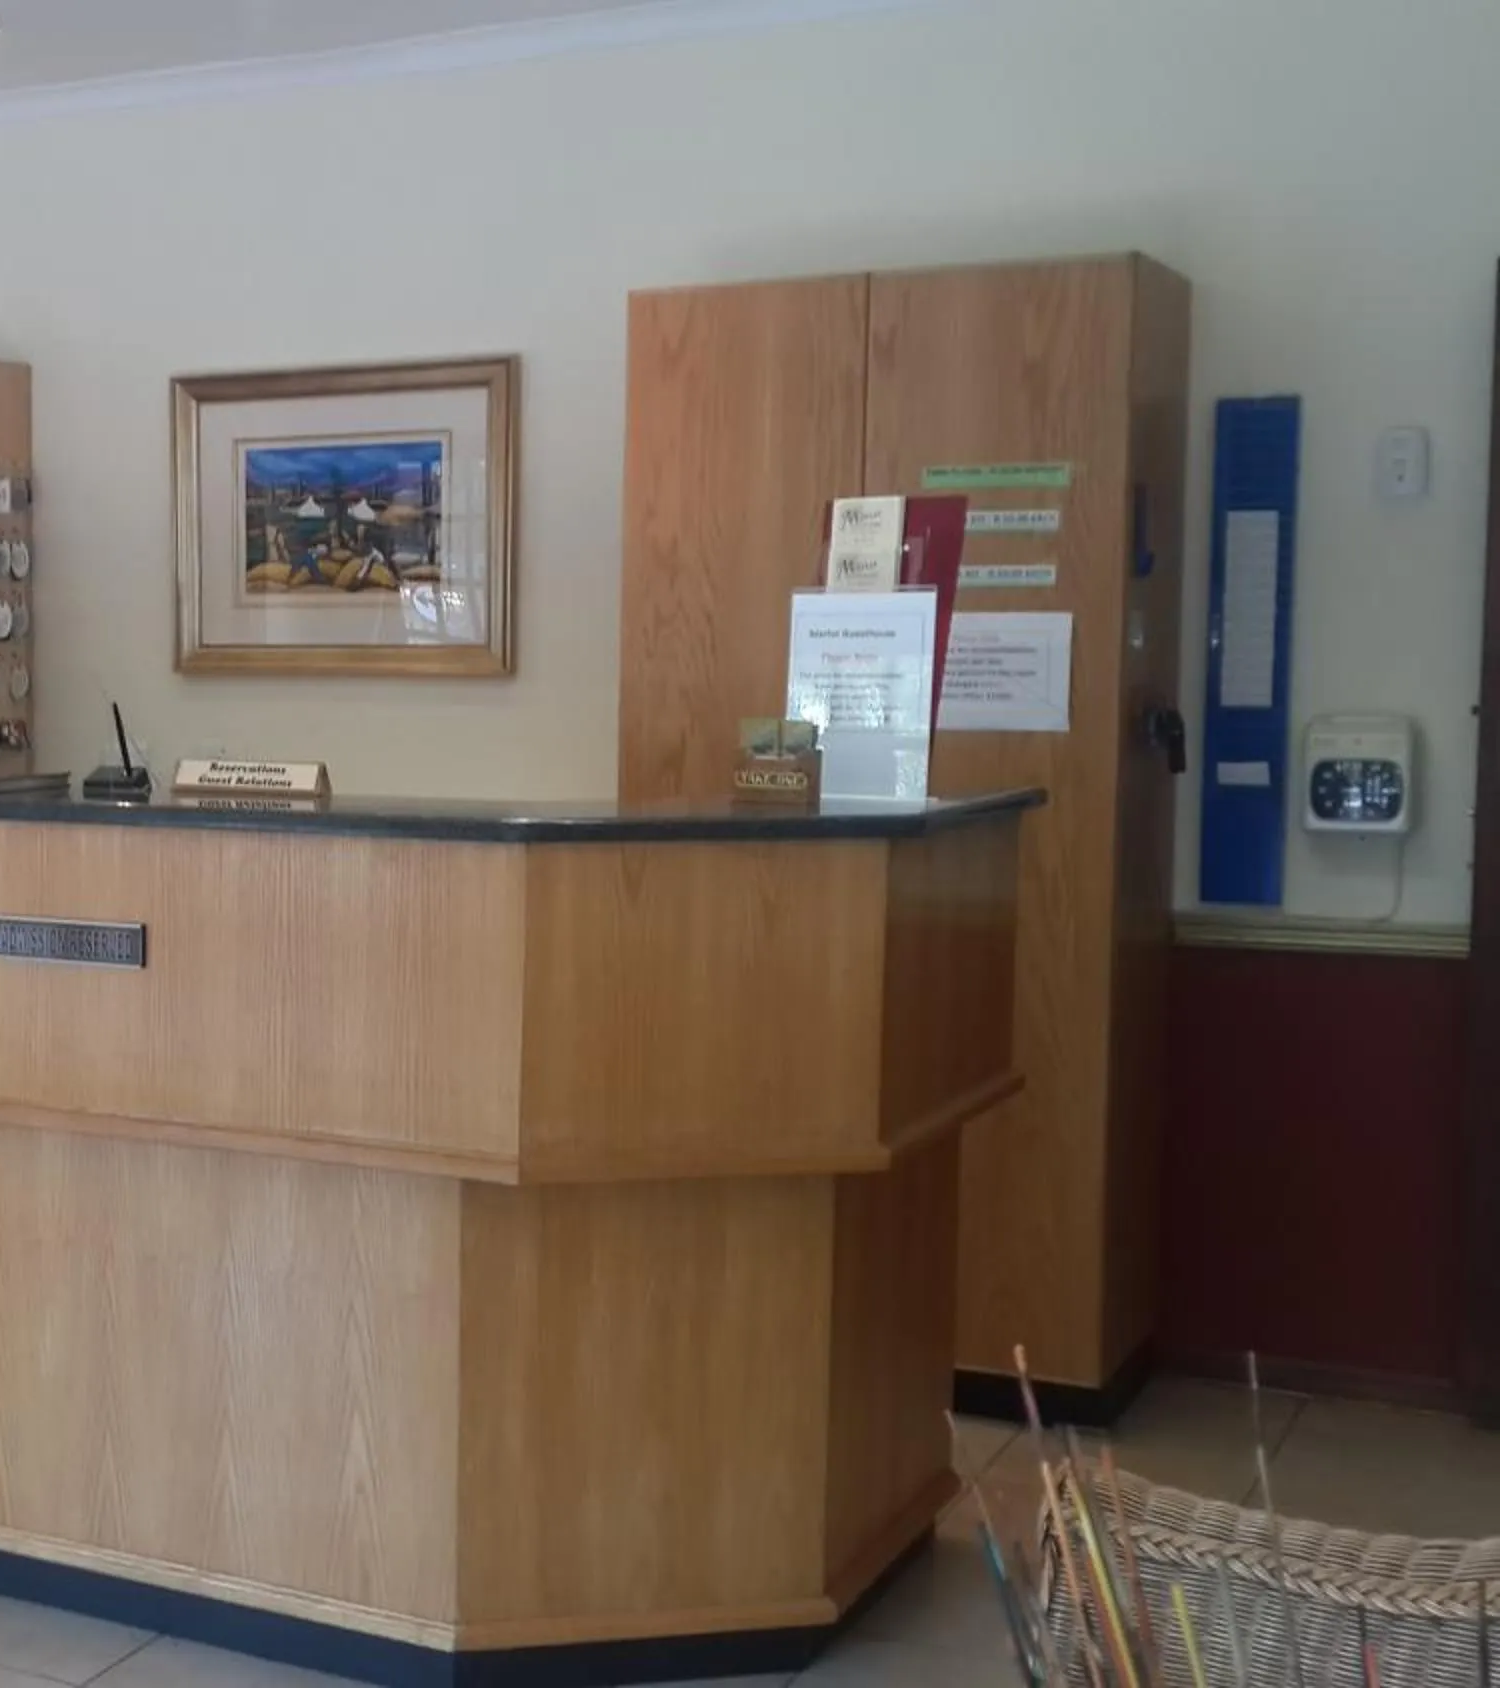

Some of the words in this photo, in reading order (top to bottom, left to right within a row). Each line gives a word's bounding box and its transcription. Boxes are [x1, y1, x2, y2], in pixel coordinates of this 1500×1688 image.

[210, 762, 286, 774] Reservations
[198, 776, 232, 785] Guest
[236, 776, 292, 788] Relations
